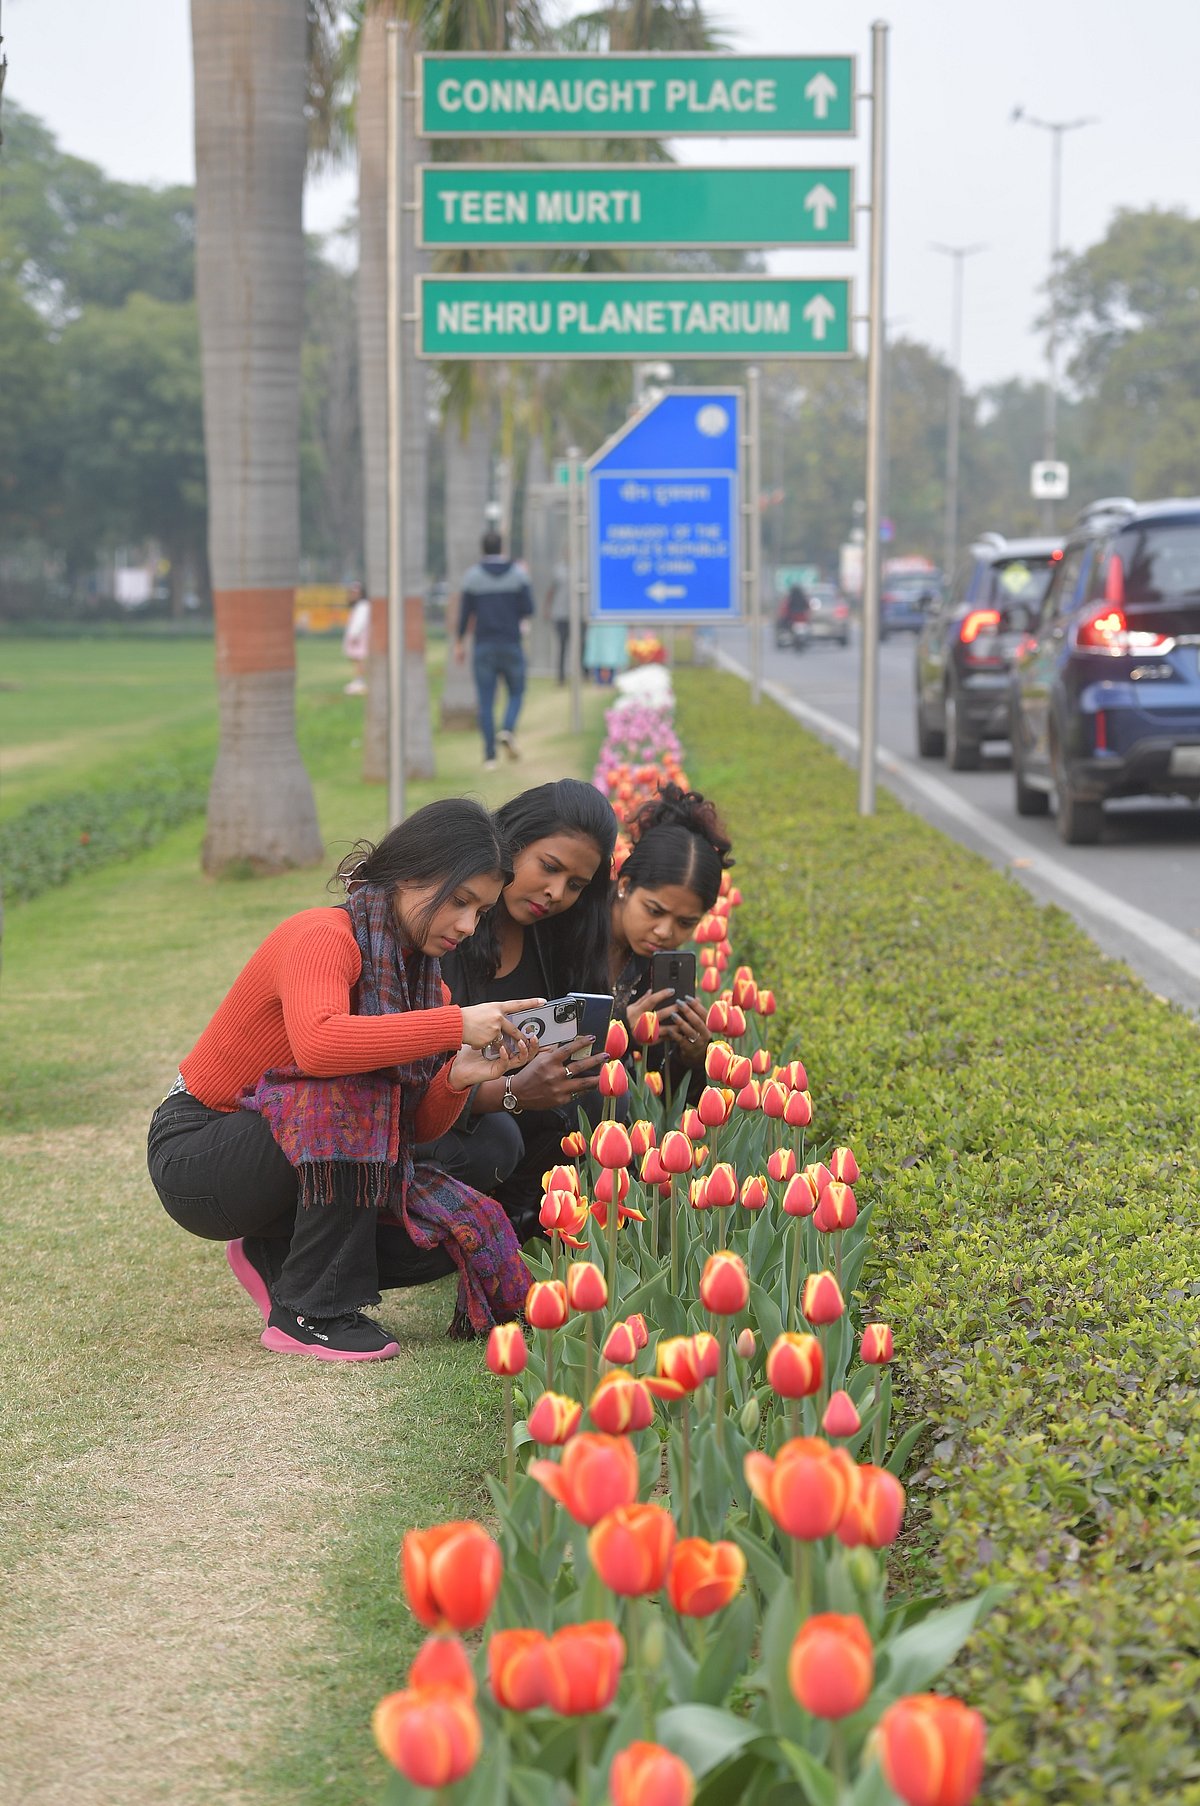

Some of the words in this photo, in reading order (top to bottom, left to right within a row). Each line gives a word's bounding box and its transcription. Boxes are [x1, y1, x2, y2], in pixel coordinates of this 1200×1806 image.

[439, 80, 655, 112] CONNAUGHT
[667, 79, 777, 112] PLACE
[440, 192, 528, 223] TEEN
[537, 191, 641, 222] MURTI
[438, 302, 551, 334] NEHRU
[558, 301, 790, 334] PLANETARIUM
